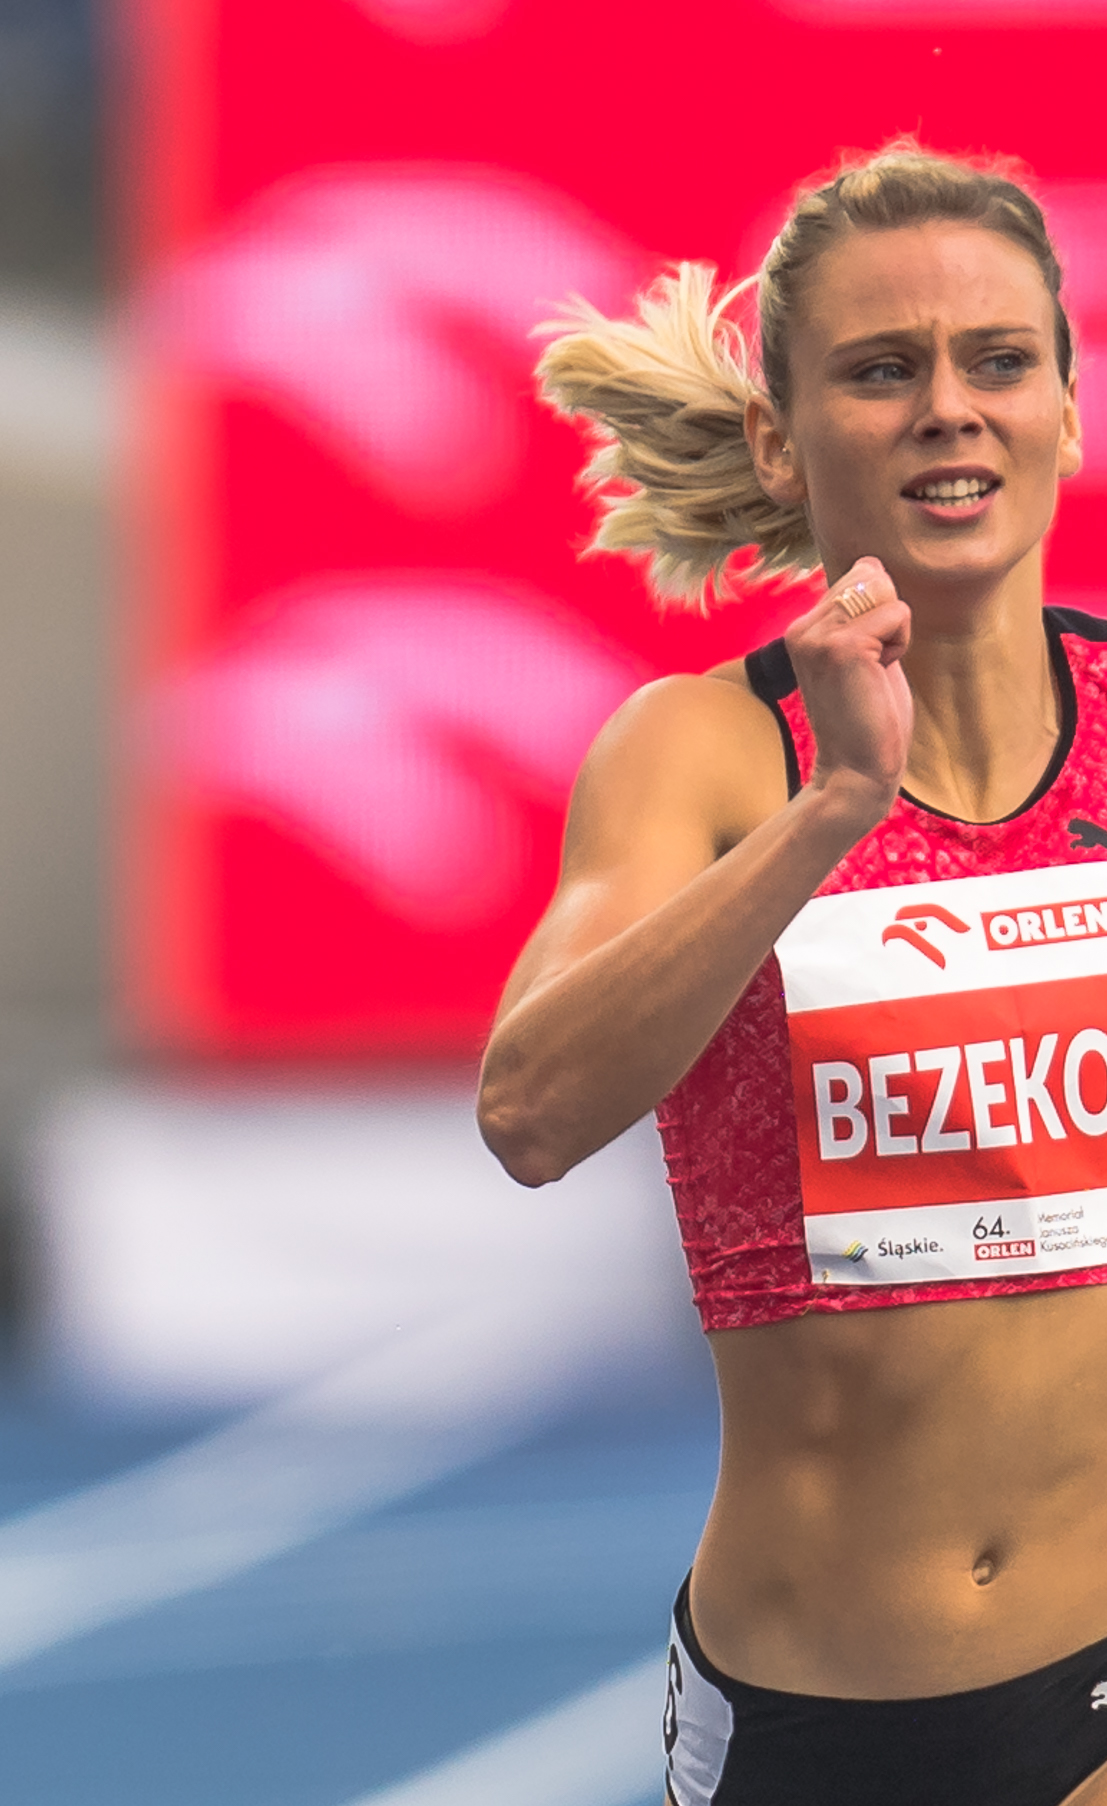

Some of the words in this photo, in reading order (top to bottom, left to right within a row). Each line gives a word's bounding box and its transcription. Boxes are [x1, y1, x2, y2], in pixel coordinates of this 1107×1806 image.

[972, 1214, 1011, 1240] 64.
[877, 1236, 945, 1260] Śląskie.
[976, 1242, 1034, 1259] ORLEN
